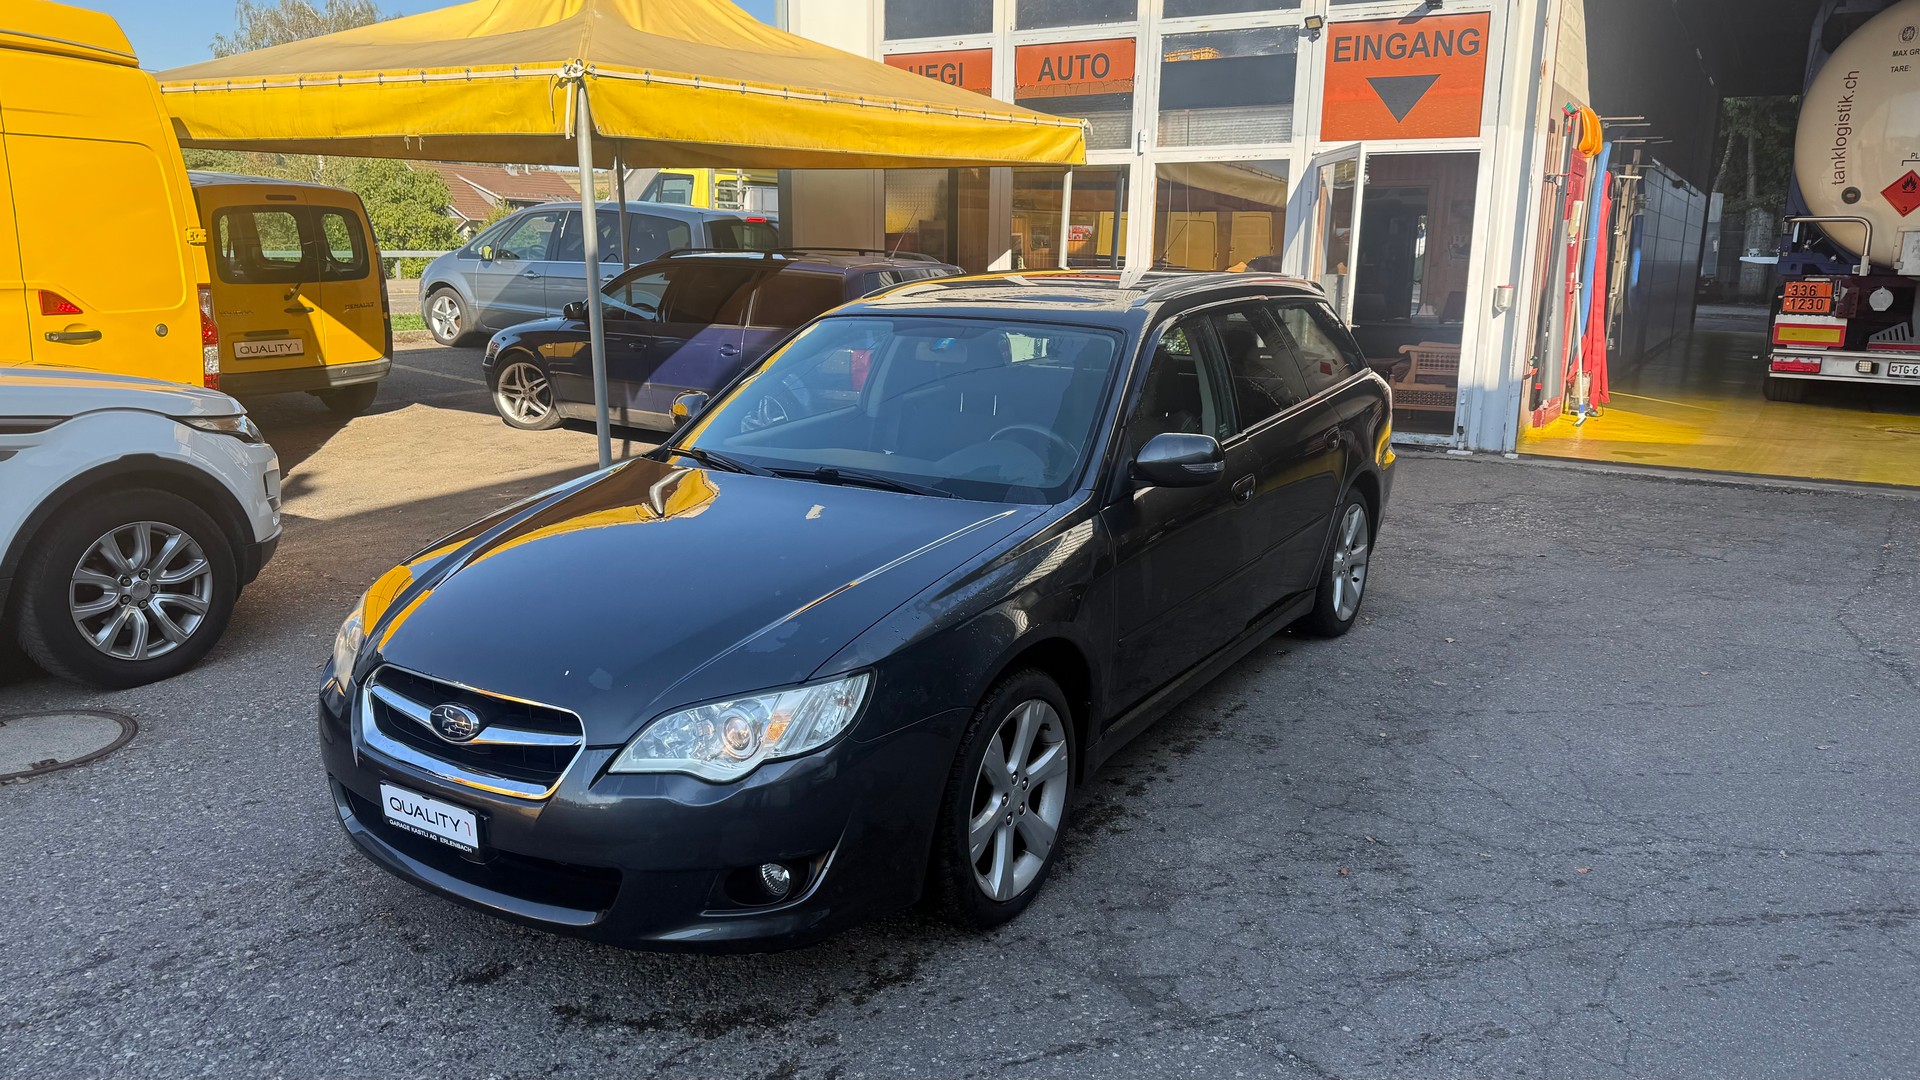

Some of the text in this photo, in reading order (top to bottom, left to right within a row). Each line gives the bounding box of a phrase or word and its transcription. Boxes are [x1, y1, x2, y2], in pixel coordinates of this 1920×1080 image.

[1334, 28, 1480, 62] EINGANG
[1037, 53, 1110, 82] AUTO
[1890, 65, 1912, 73] TARE:
[1831, 70, 1860, 185] tanklogistik.ch
[1789, 298, 1824, 310] 1230
[1791, 285, 1817, 296] 336
[240, 343, 292, 354] QUALITY
[389, 796, 460, 832] QUALITY
[389, 819, 411, 832] GARAGE
[440, 837, 473, 853] ERLENBACH
